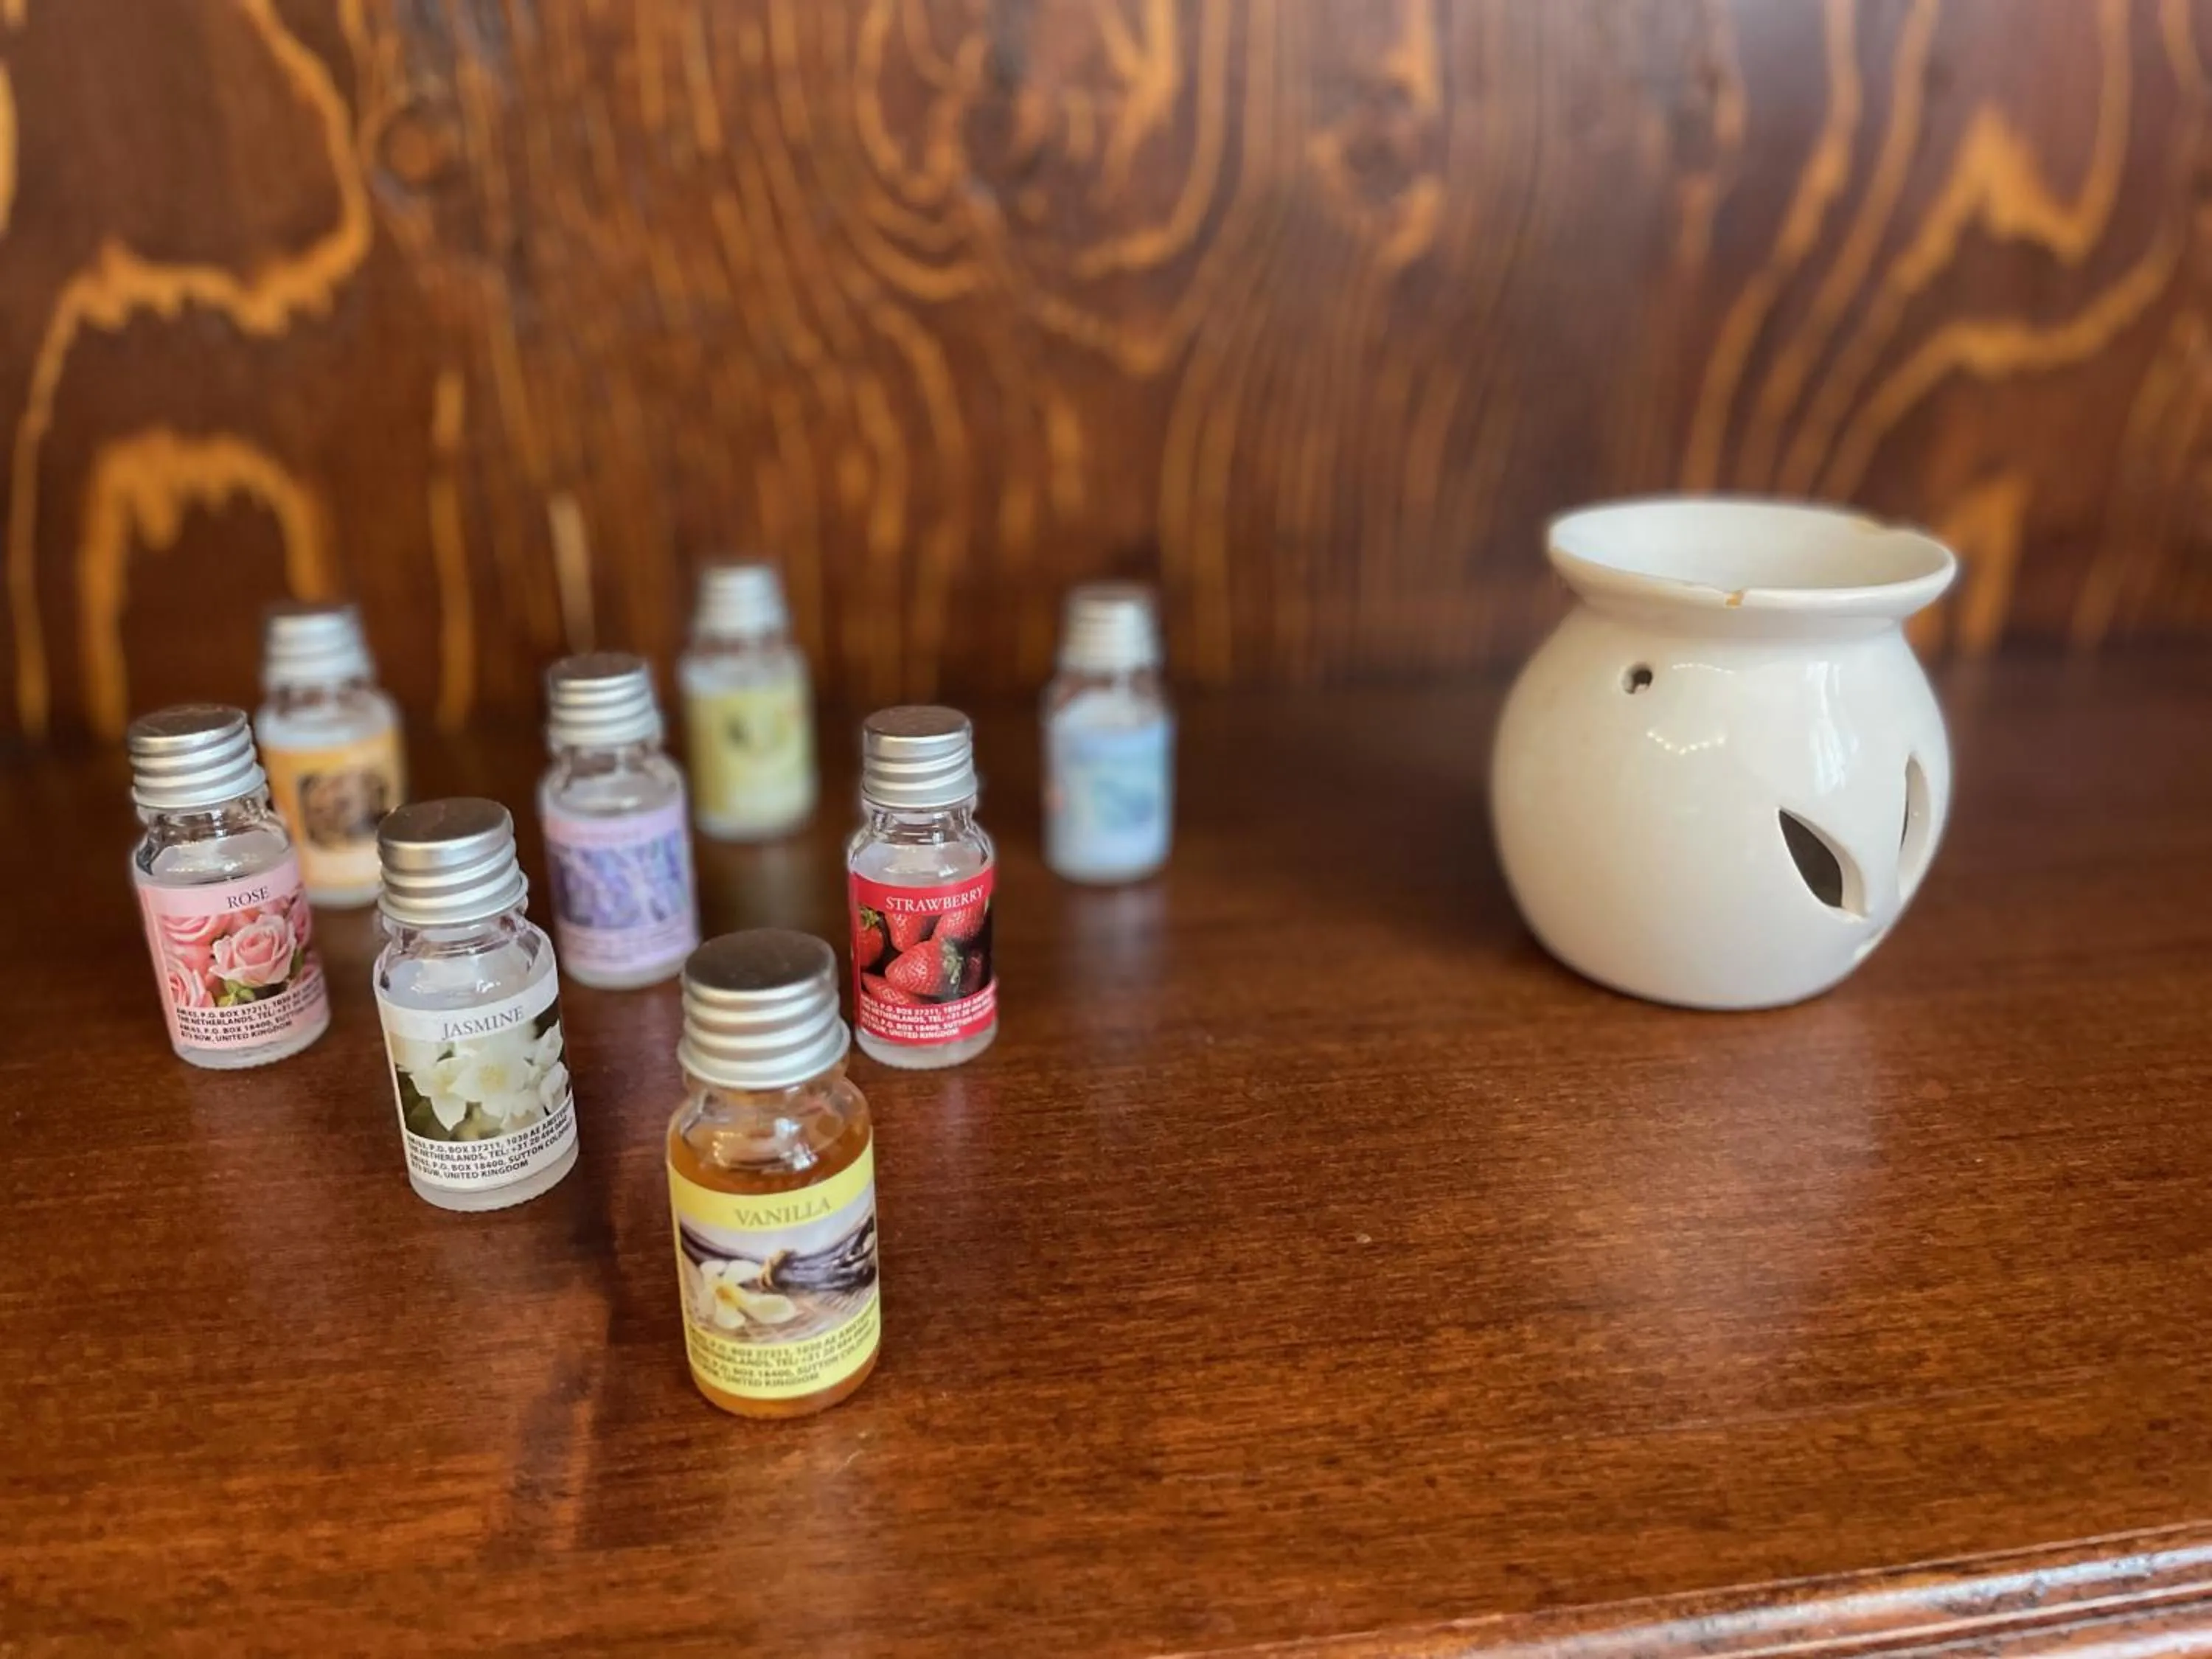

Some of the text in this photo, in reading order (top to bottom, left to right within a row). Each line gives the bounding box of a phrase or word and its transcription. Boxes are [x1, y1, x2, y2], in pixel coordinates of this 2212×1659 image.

[226, 887, 269, 908] ROSE
[886, 885, 984, 912] STRAWBERRY
[215, 1033, 249, 1041] UNITED
[251, 1020, 291, 1037] KINGDOM
[442, 1006, 524, 1040] JASMINE
[509, 1144, 543, 1163] SUTTON
[444, 1171, 479, 1180] UNITED
[481, 1159, 529, 1177] KINGDOM
[735, 1197, 831, 1227] VANILLA
